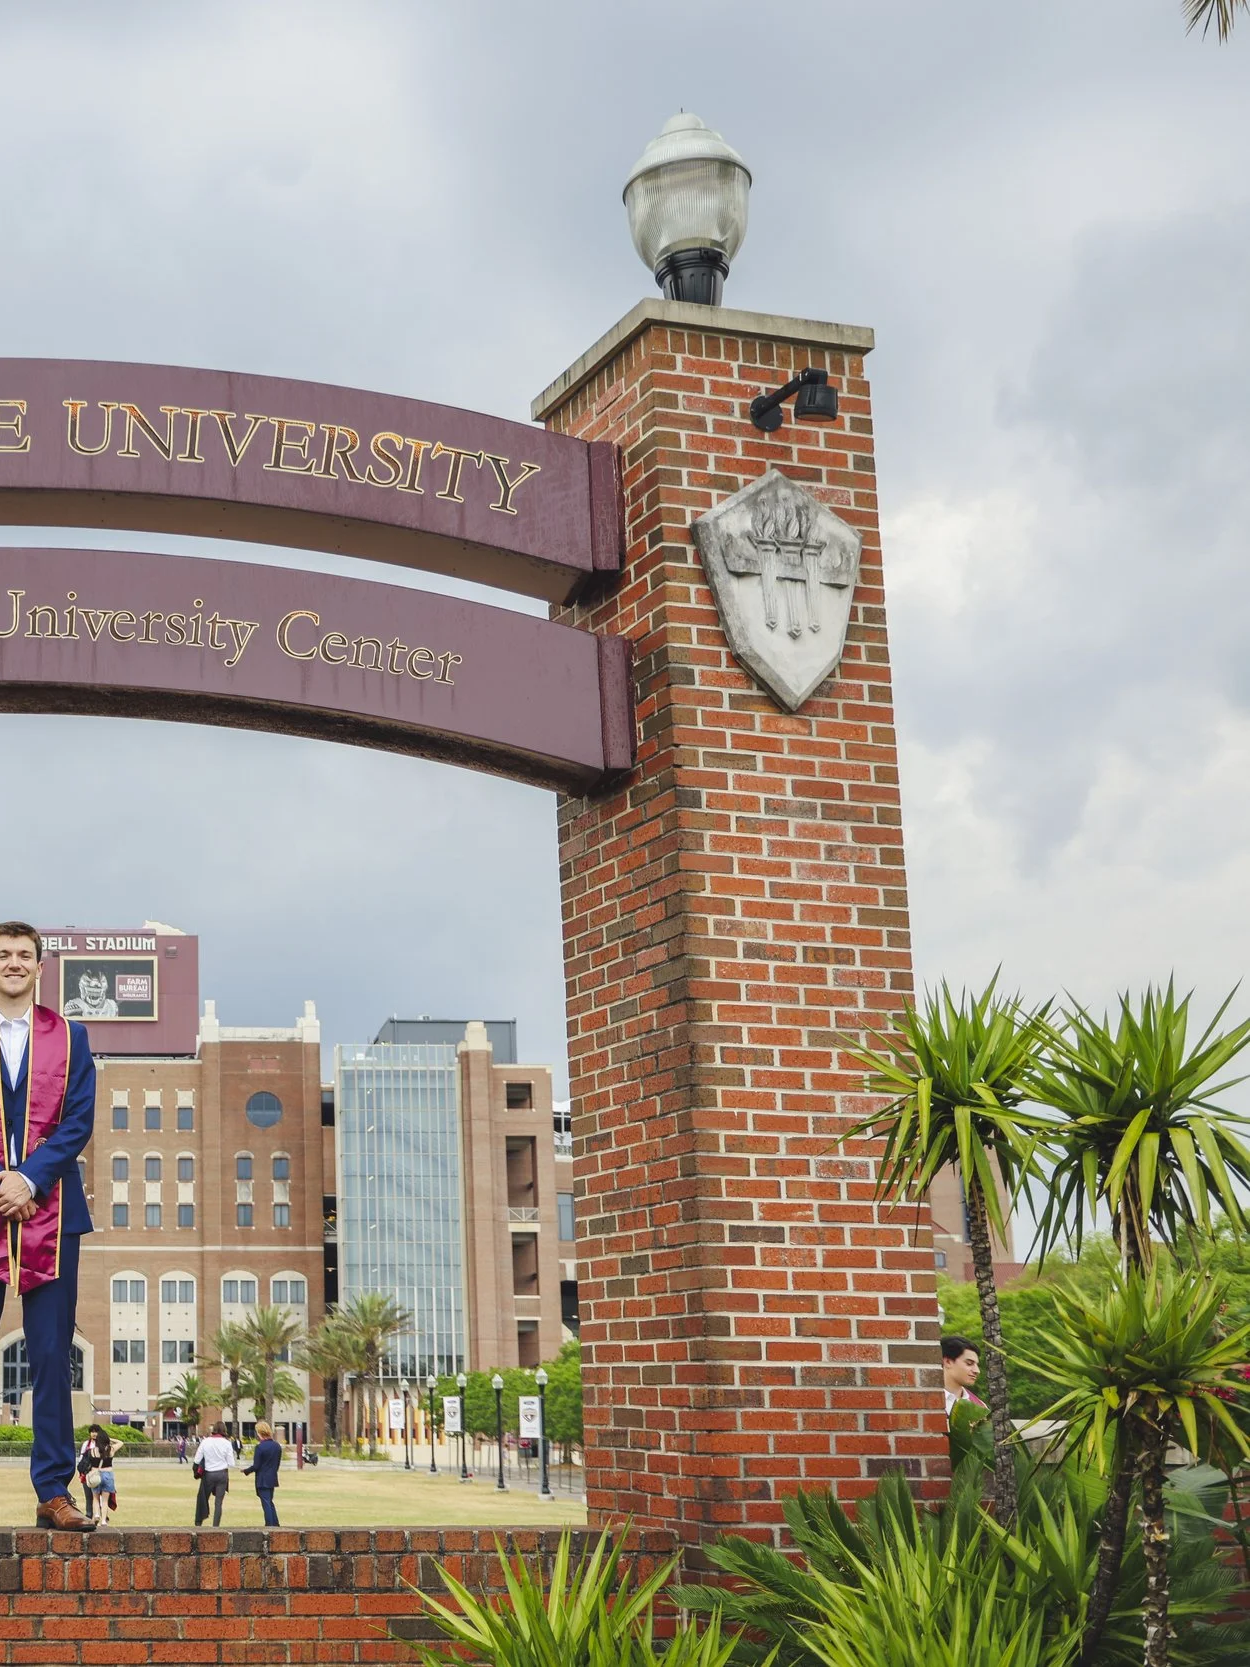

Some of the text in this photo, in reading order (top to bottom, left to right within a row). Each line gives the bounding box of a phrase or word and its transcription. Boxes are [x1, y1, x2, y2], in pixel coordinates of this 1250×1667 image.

[62, 398, 541, 515] UNIVERSITY
[275, 610, 463, 686] Center
[41, 936, 78, 950] BELL
[85, 936, 156, 951] STADIUM
[118, 984, 148, 992] BUREAU
[126, 977, 148, 985] FARM
